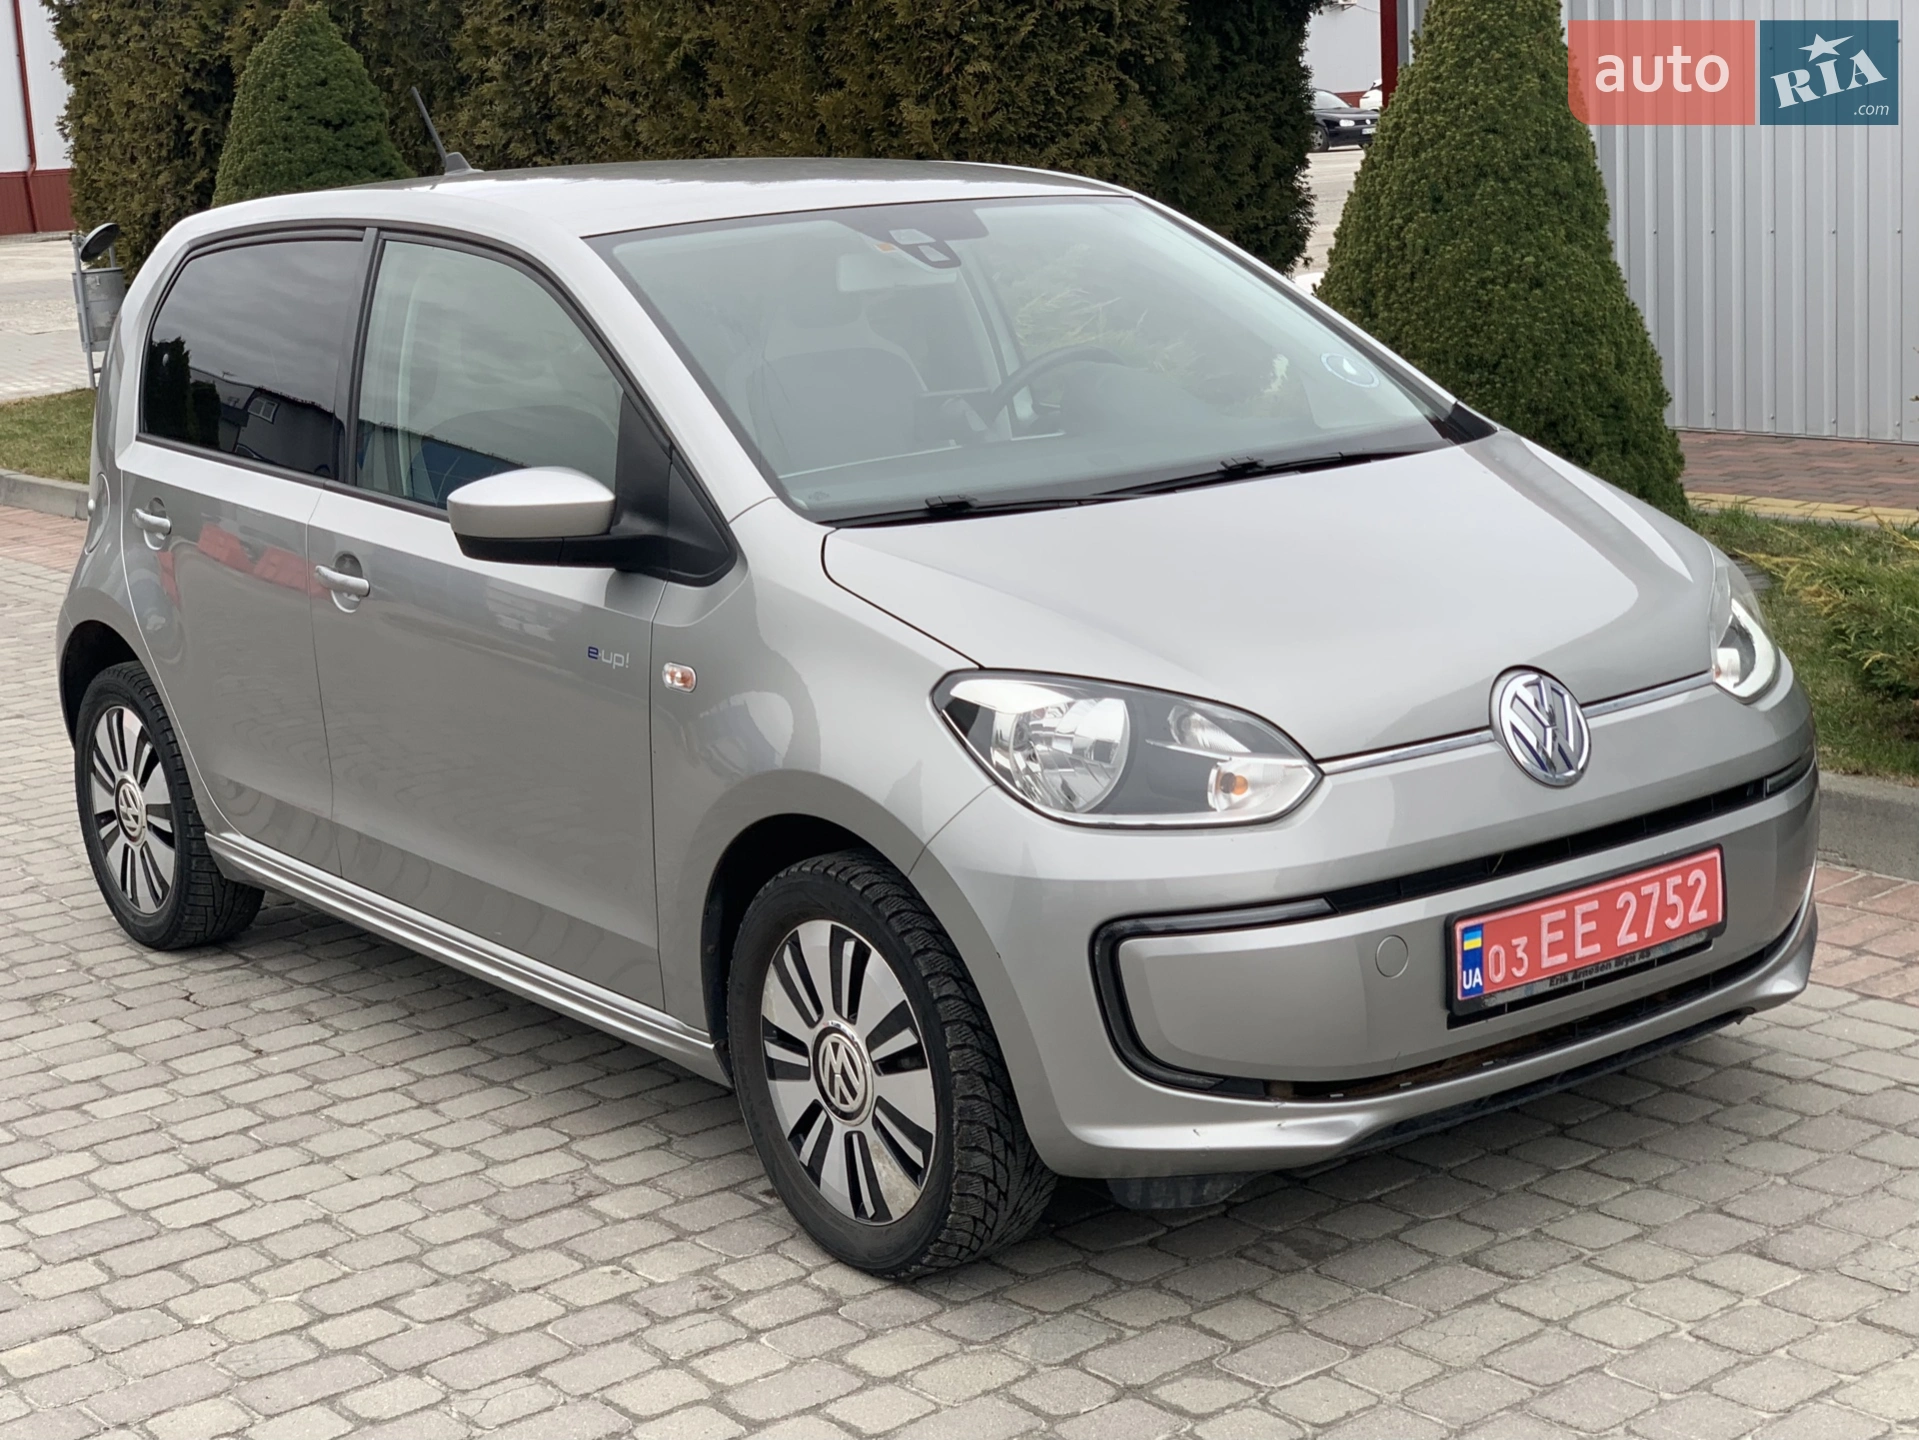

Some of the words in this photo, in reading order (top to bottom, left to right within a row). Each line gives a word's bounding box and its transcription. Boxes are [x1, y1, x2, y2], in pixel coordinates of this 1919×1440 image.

[1487, 935, 1529, 984] 03
[1540, 899, 1601, 969] EE
[1616, 868, 1708, 948] 2752
[1462, 967, 1483, 990] UA
[1549, 974, 1569, 988] Erik
